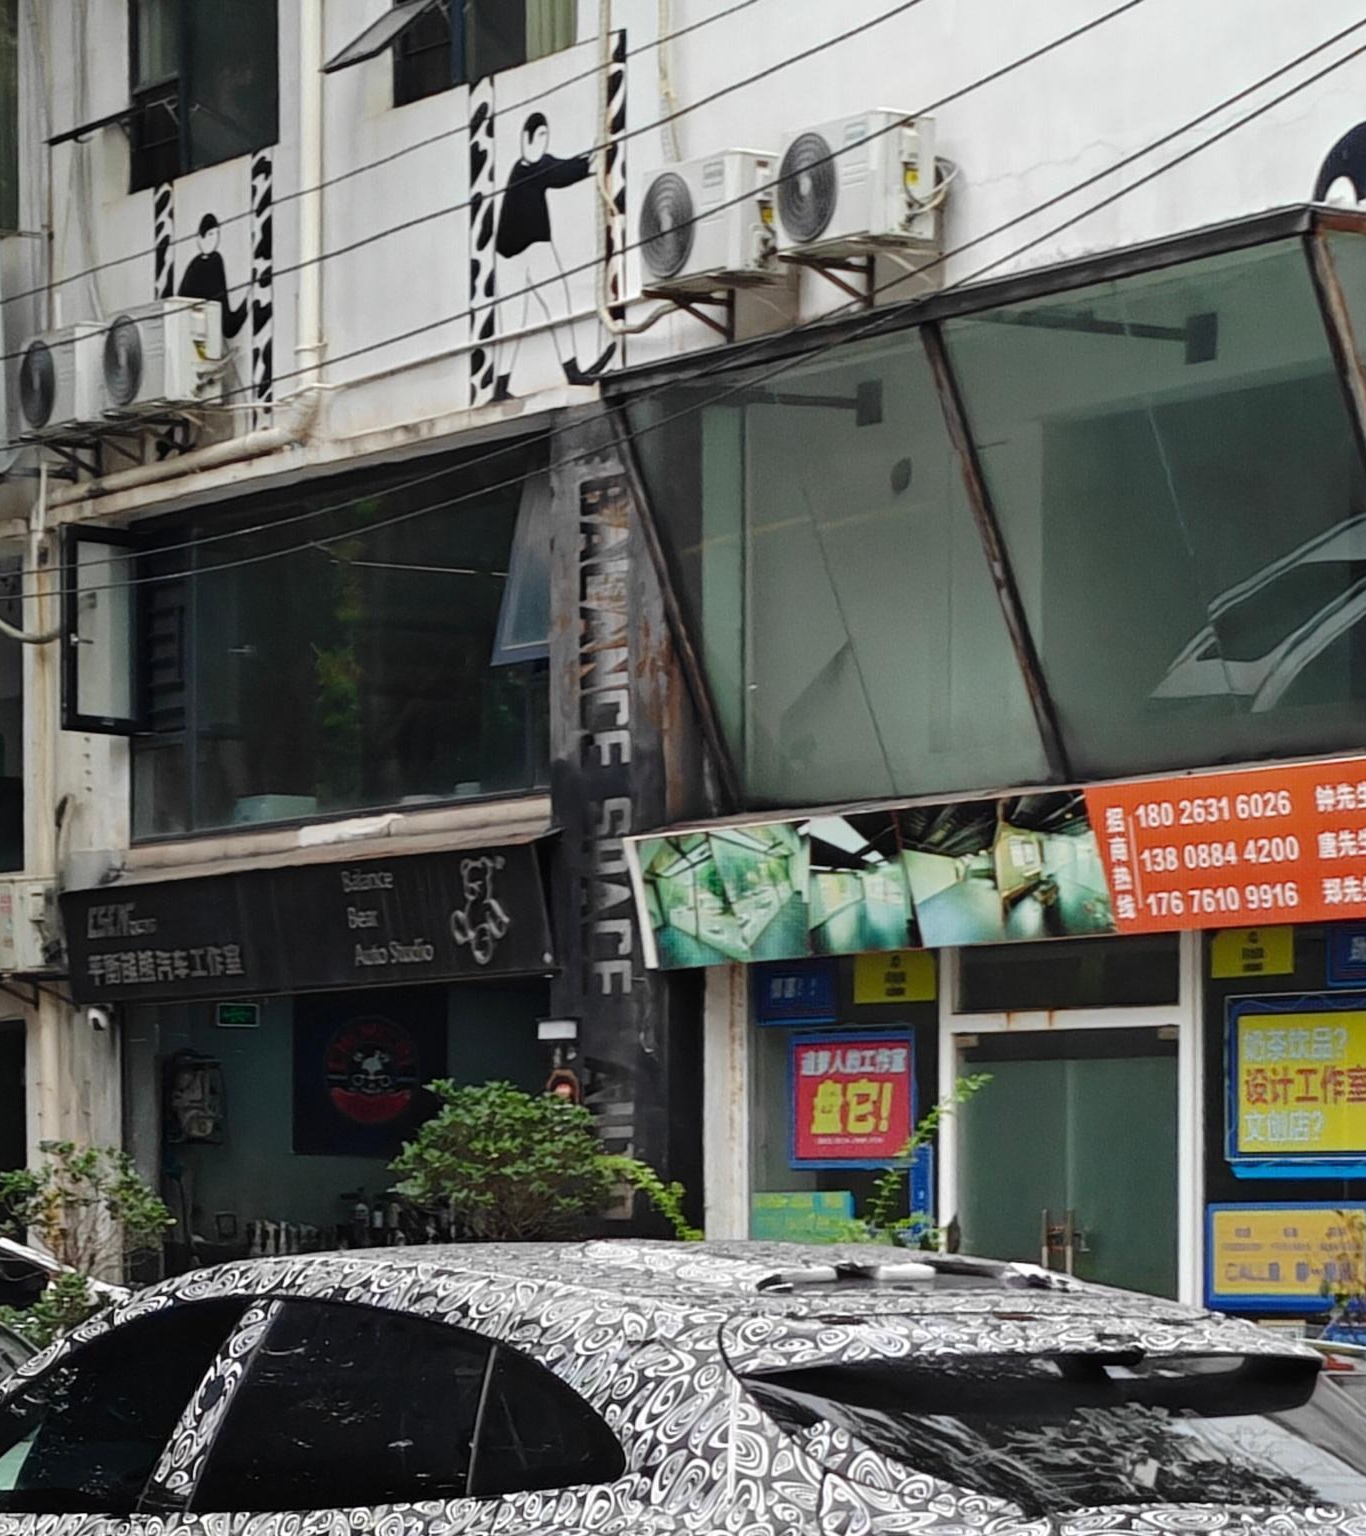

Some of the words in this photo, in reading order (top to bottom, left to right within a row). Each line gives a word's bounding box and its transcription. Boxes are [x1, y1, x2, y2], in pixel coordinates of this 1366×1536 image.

[1137, 802, 1173, 828] 180
[1179, 792, 1231, 823] 2631
[1236, 790, 1291, 819] 6026
[1141, 845, 1178, 873] 138
[1183, 841, 1236, 868] 0884
[1243, 836, 1299, 865] 4200
[341, 870, 394, 892] Balance
[1146, 889, 1185, 917] 176
[1188, 887, 1240, 914] 7610
[1247, 881, 1299, 909] 9916
[355, 943, 388, 966] Auto
[389, 938, 434, 964] Studio
